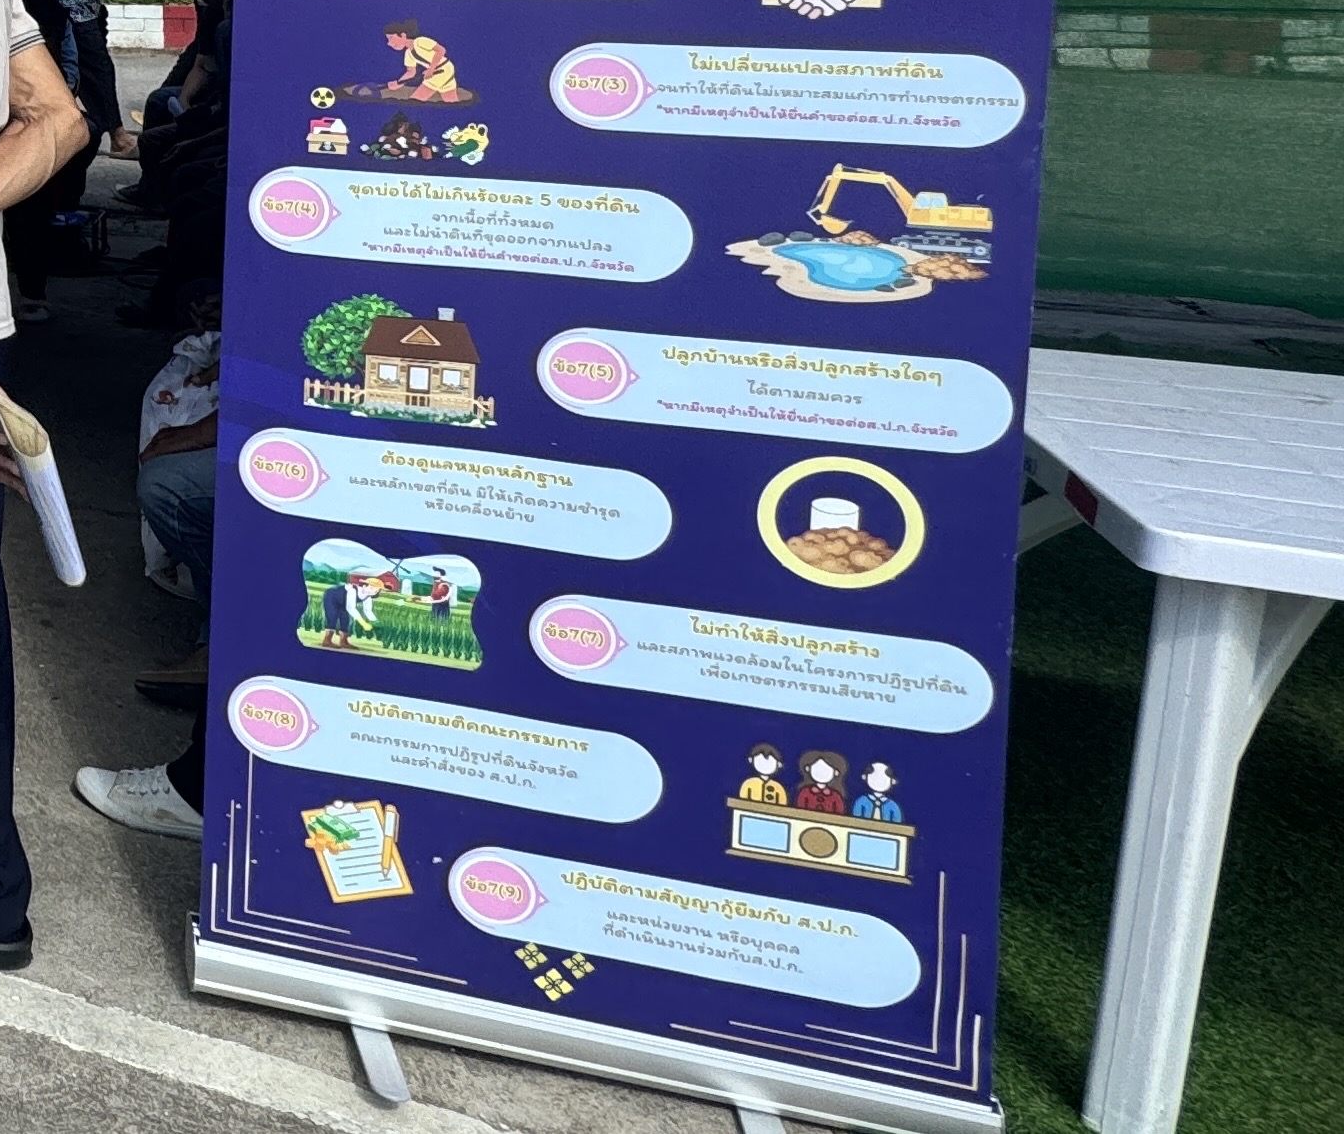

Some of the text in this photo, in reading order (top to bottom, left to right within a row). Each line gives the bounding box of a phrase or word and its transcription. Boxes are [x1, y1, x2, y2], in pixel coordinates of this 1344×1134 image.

[688, 50, 944, 81] ไม่เปลี่ยนแปลงสภาพที่ดิน
[564, 73, 629, 94] ข้อ7(3)
[262, 198, 318, 217] ข้อ7(4)
[348, 181, 640, 215] ขุดบ่อได้ไม่เกินร้อยละ 5 ของที่ดิน
[430, 208, 555, 231] จากเนื้อที่ทั้งหมด
[552, 358, 615, 381] ข้อ7(5)
[661, 345, 943, 388] ปลูกบ้านหรือสิ่งปลูกสร้างใดๆ
[746, 379, 863, 405] ได้ตามสมควร
[253, 457, 308, 480] ข้อ7(6)
[381, 449, 574, 489] ต้องดูแลหมุดหลักฐาน
[544, 623, 605, 648] ข้อ7(7)
[689, 615, 881, 659] ไม่ทำให้สิ่งปลูกสร้าง
[700, 665, 896, 704] เพื่อเกษตรกรรมเสียหาย
[242, 704, 296, 730] ข้อ7(8)
[347, 700, 589, 753] ปฏิบัติตามมติคณะกรรมการ
[489, 772, 537, 790] ส.ป.ก.
[464, 875, 524, 903] ข้อ7(9)
[560, 871, 861, 939] ปฏิบัติตามสัญญากู้ยืมกับ ส.ป.ก.
[606, 908, 713, 939] และหน่วยงาน
